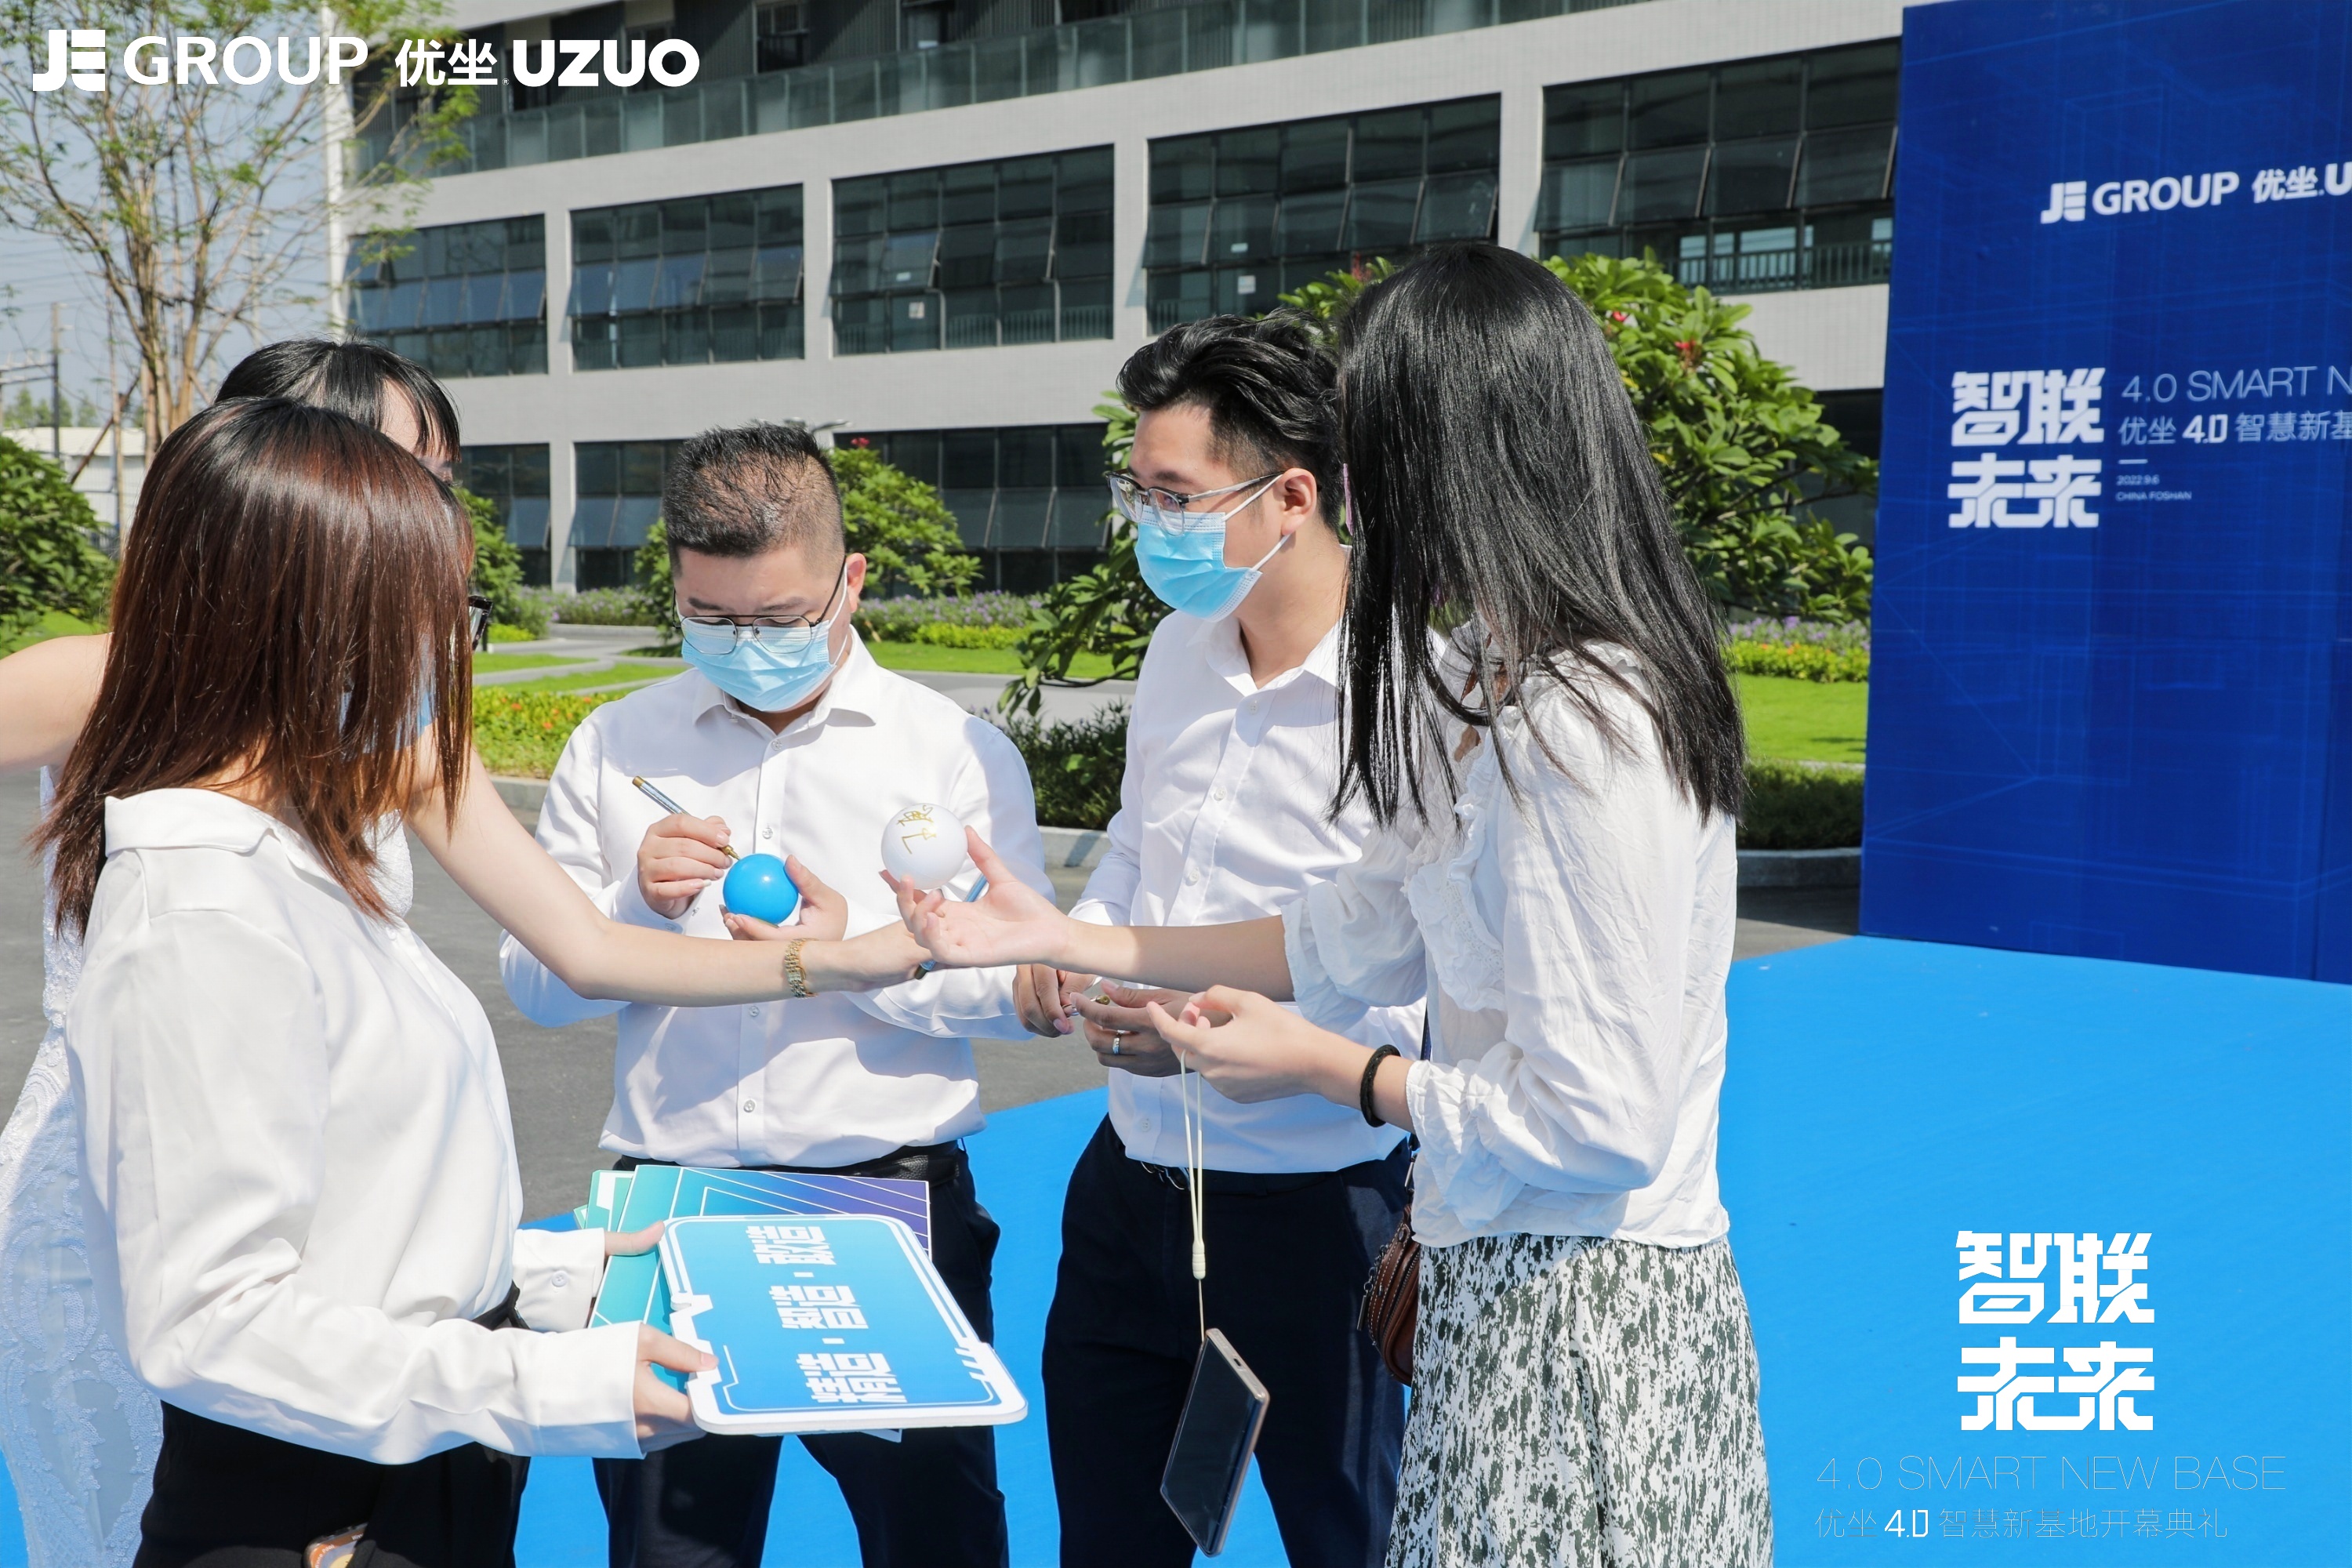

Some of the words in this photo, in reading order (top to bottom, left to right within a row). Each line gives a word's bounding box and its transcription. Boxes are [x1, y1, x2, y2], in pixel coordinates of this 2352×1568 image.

[2092, 171, 2240, 216] GROUP
[2252, 165, 2318, 204] 优坐
[2121, 373, 2177, 403] 4.0
[2187, 366, 2318, 401] SMART
[1952, 368, 2105, 446] 智联
[2118, 415, 2176, 445] 优坐
[2182, 413, 2228, 444] 4.0
[1947, 452, 2102, 528] 未来
[2115, 491, 2147, 501] CHINA
[2149, 490, 2192, 501] FOSHAN
